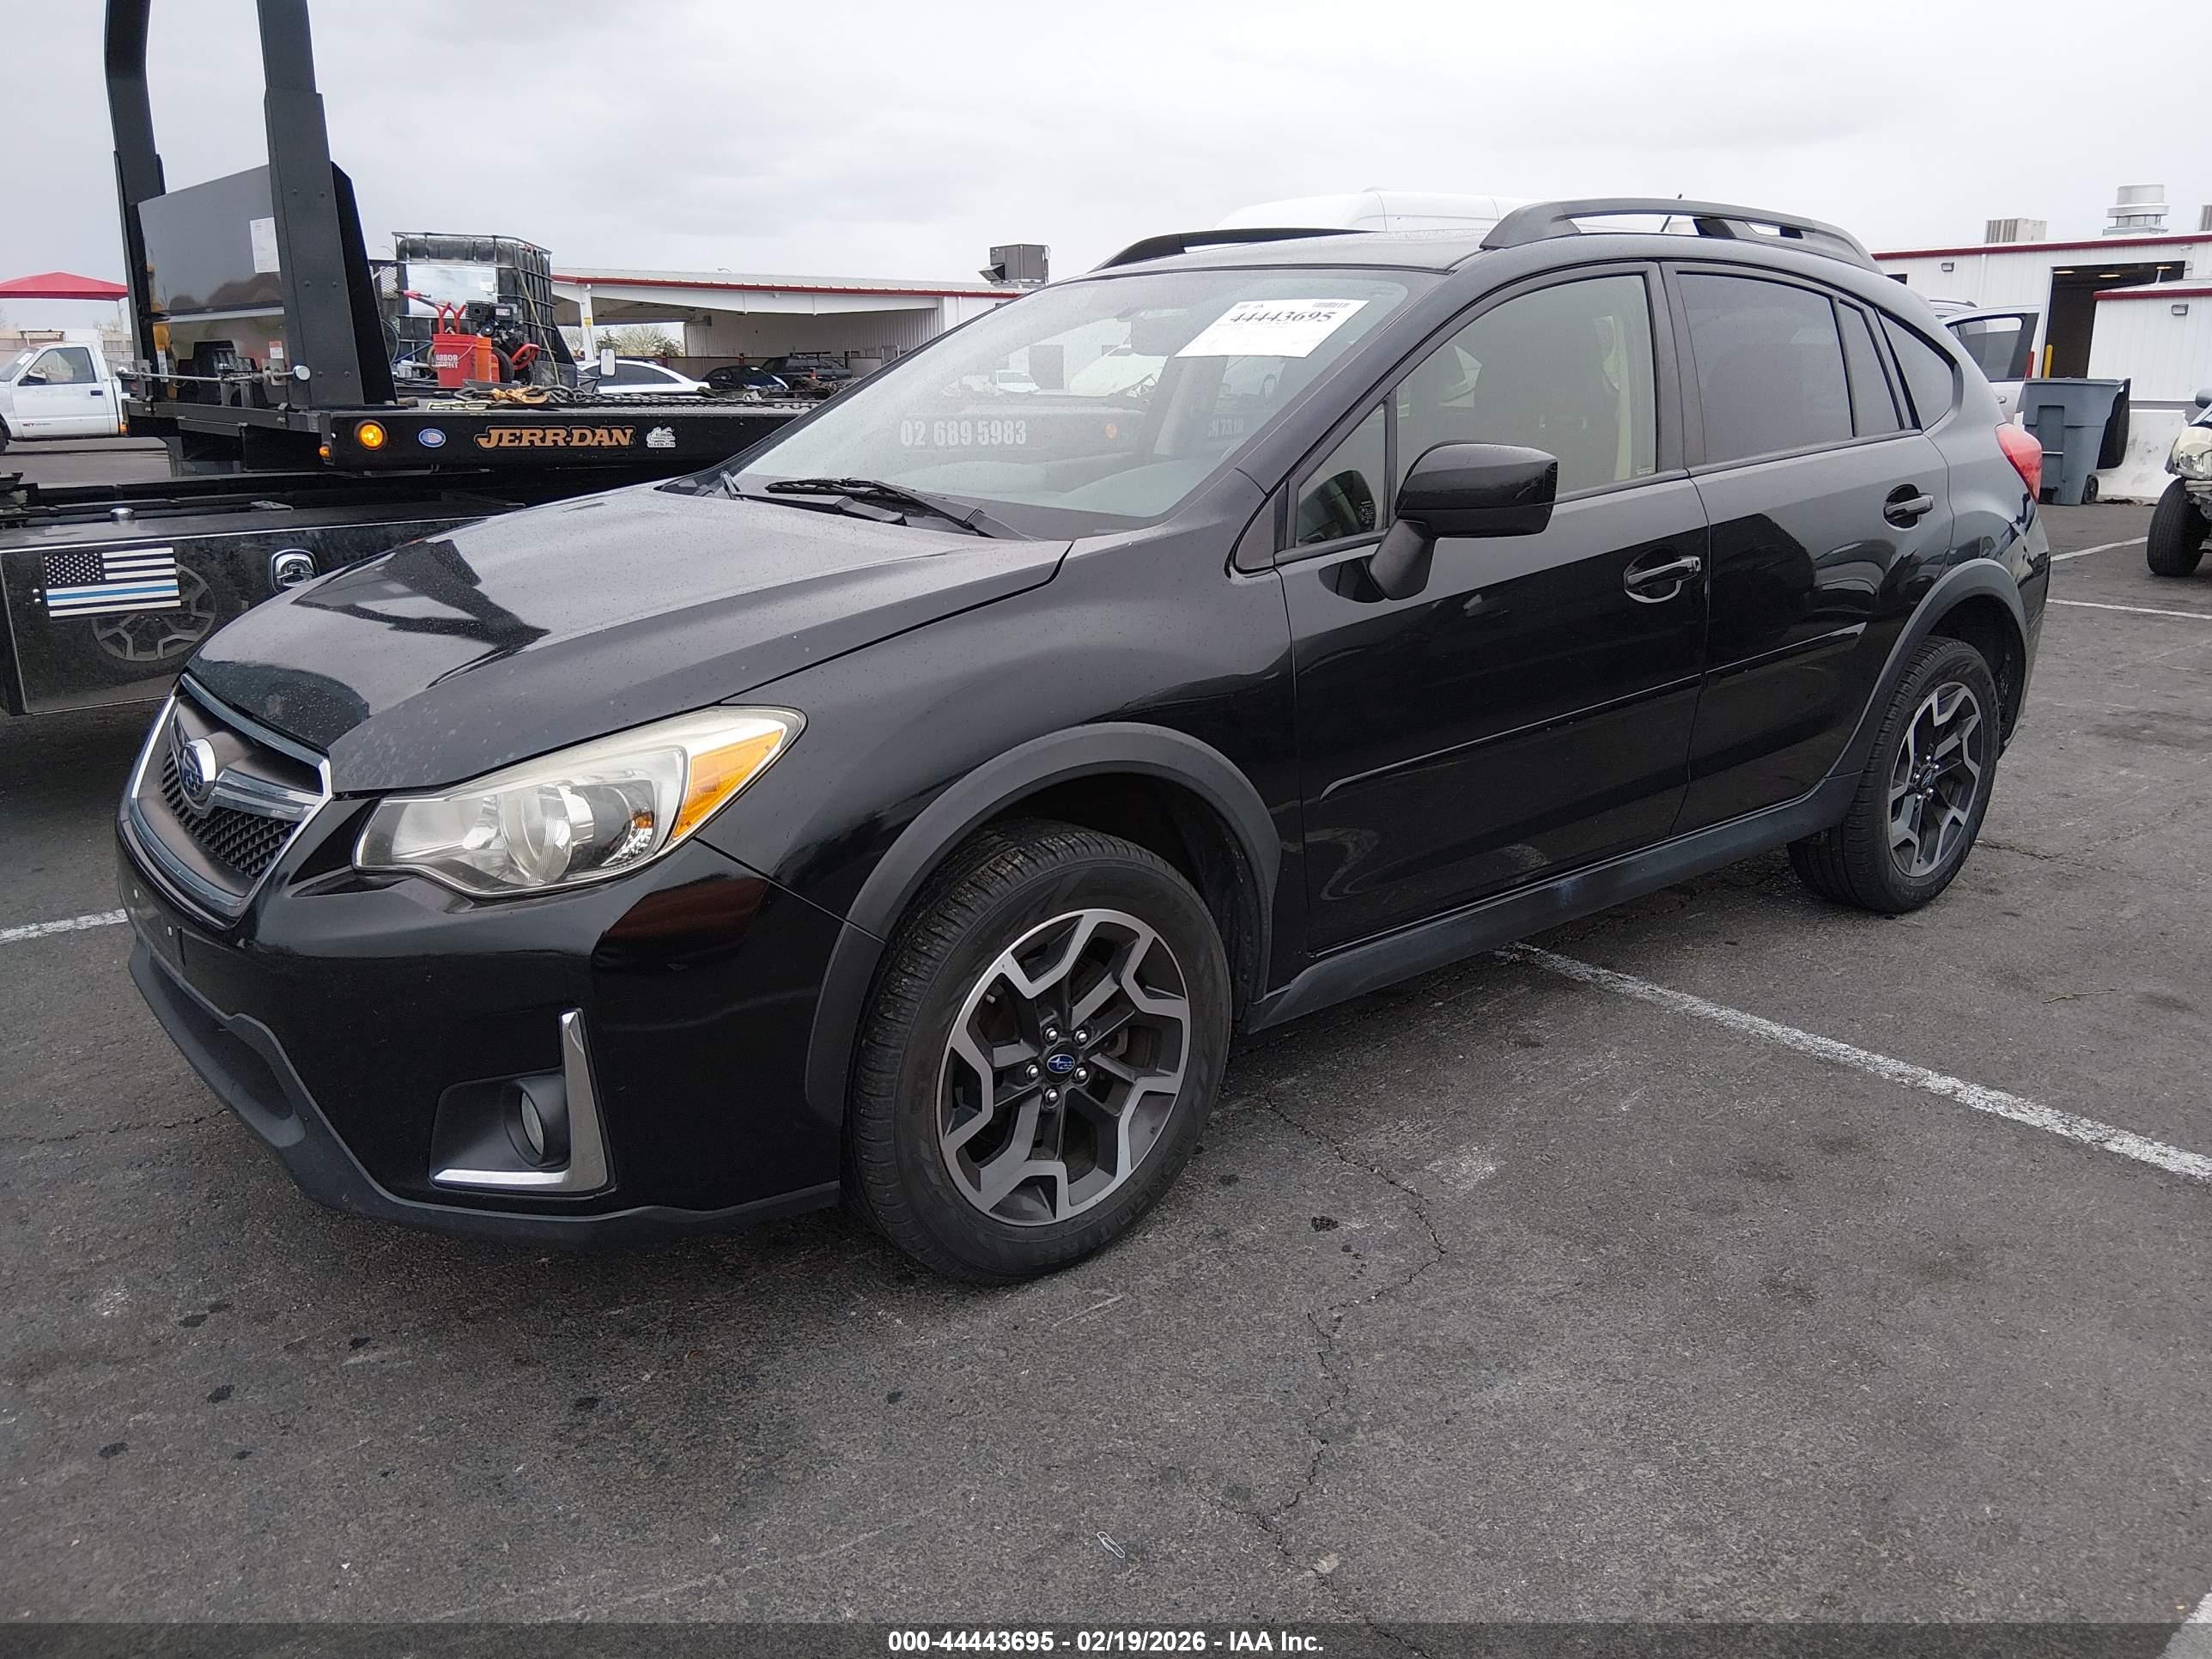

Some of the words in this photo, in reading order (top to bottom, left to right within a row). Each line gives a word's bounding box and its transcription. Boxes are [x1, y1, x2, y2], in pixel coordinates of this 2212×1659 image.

[1230, 311, 1338, 323] 44443695
[474, 427, 635, 448] JERR-DAN
[933, 419, 973, 447] 689
[977, 419, 1027, 447] 5983
